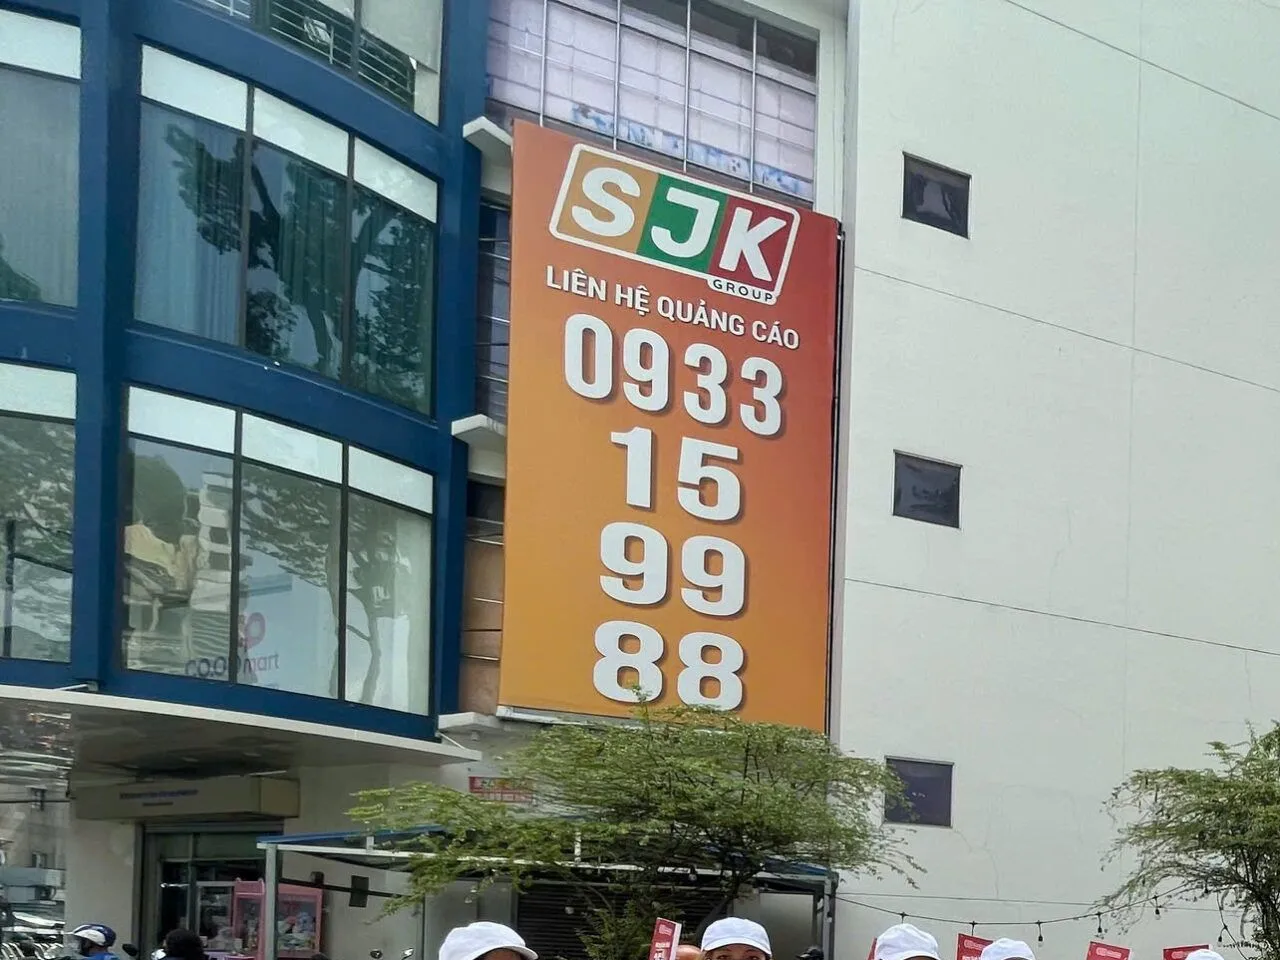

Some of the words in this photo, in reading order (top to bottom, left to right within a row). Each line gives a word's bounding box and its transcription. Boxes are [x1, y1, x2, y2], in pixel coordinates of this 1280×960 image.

[571, 167, 786, 282] SJK
[546, 265, 607, 301] LIÊN
[615, 284, 650, 316] HỆ
[657, 295, 745, 336] QUẢNG
[751, 320, 800, 350] CÁO
[712, 278, 774, 303] GROUP
[564, 313, 783, 436] 0933
[610, 426, 741, 521] 15
[599, 521, 746, 617] 99
[592, 620, 744, 712] 88
